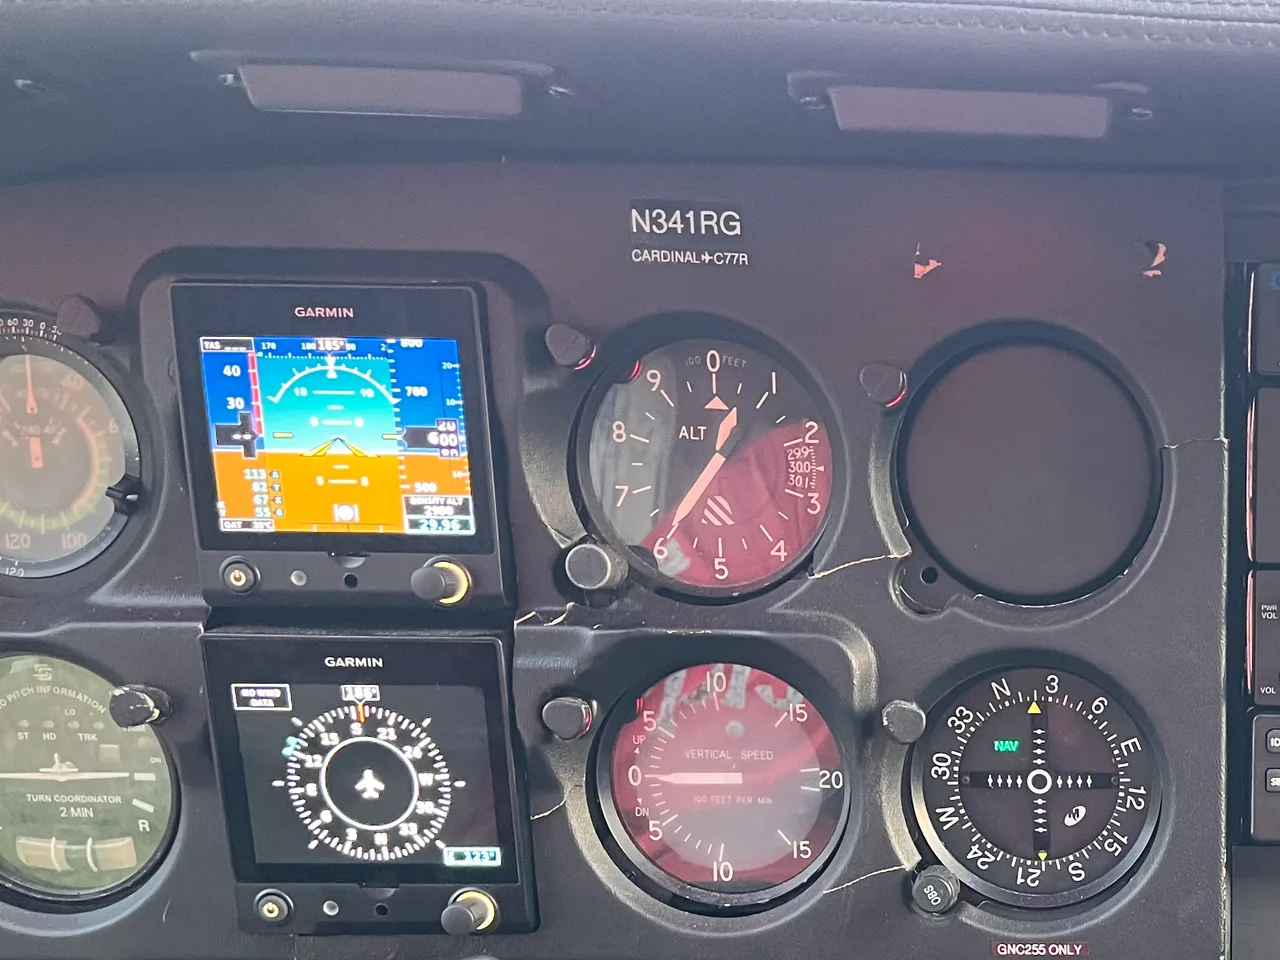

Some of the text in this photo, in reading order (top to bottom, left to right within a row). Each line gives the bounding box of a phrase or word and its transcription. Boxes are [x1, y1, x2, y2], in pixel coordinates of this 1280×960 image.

[630, 209, 741, 236] N341RG
[631, 249, 749, 265] CARDINAL C77R
[294, 307, 354, 318] GARMIN
[406, 386, 428, 396] 700
[226, 397, 244, 410] 30
[679, 425, 707, 440] ALT
[804, 421, 819, 444] 2
[713, 557, 729, 580] 5
[324, 656, 383, 668] GARMIN
[994, 740, 1018, 752] NAV
[685, 748, 774, 761] VERTICAL SPEED
[818, 770, 844, 790] 20
[26, 794, 121, 804] TURN COORDINATOR
[997, 943, 1083, 956] GNC255 ONLY
